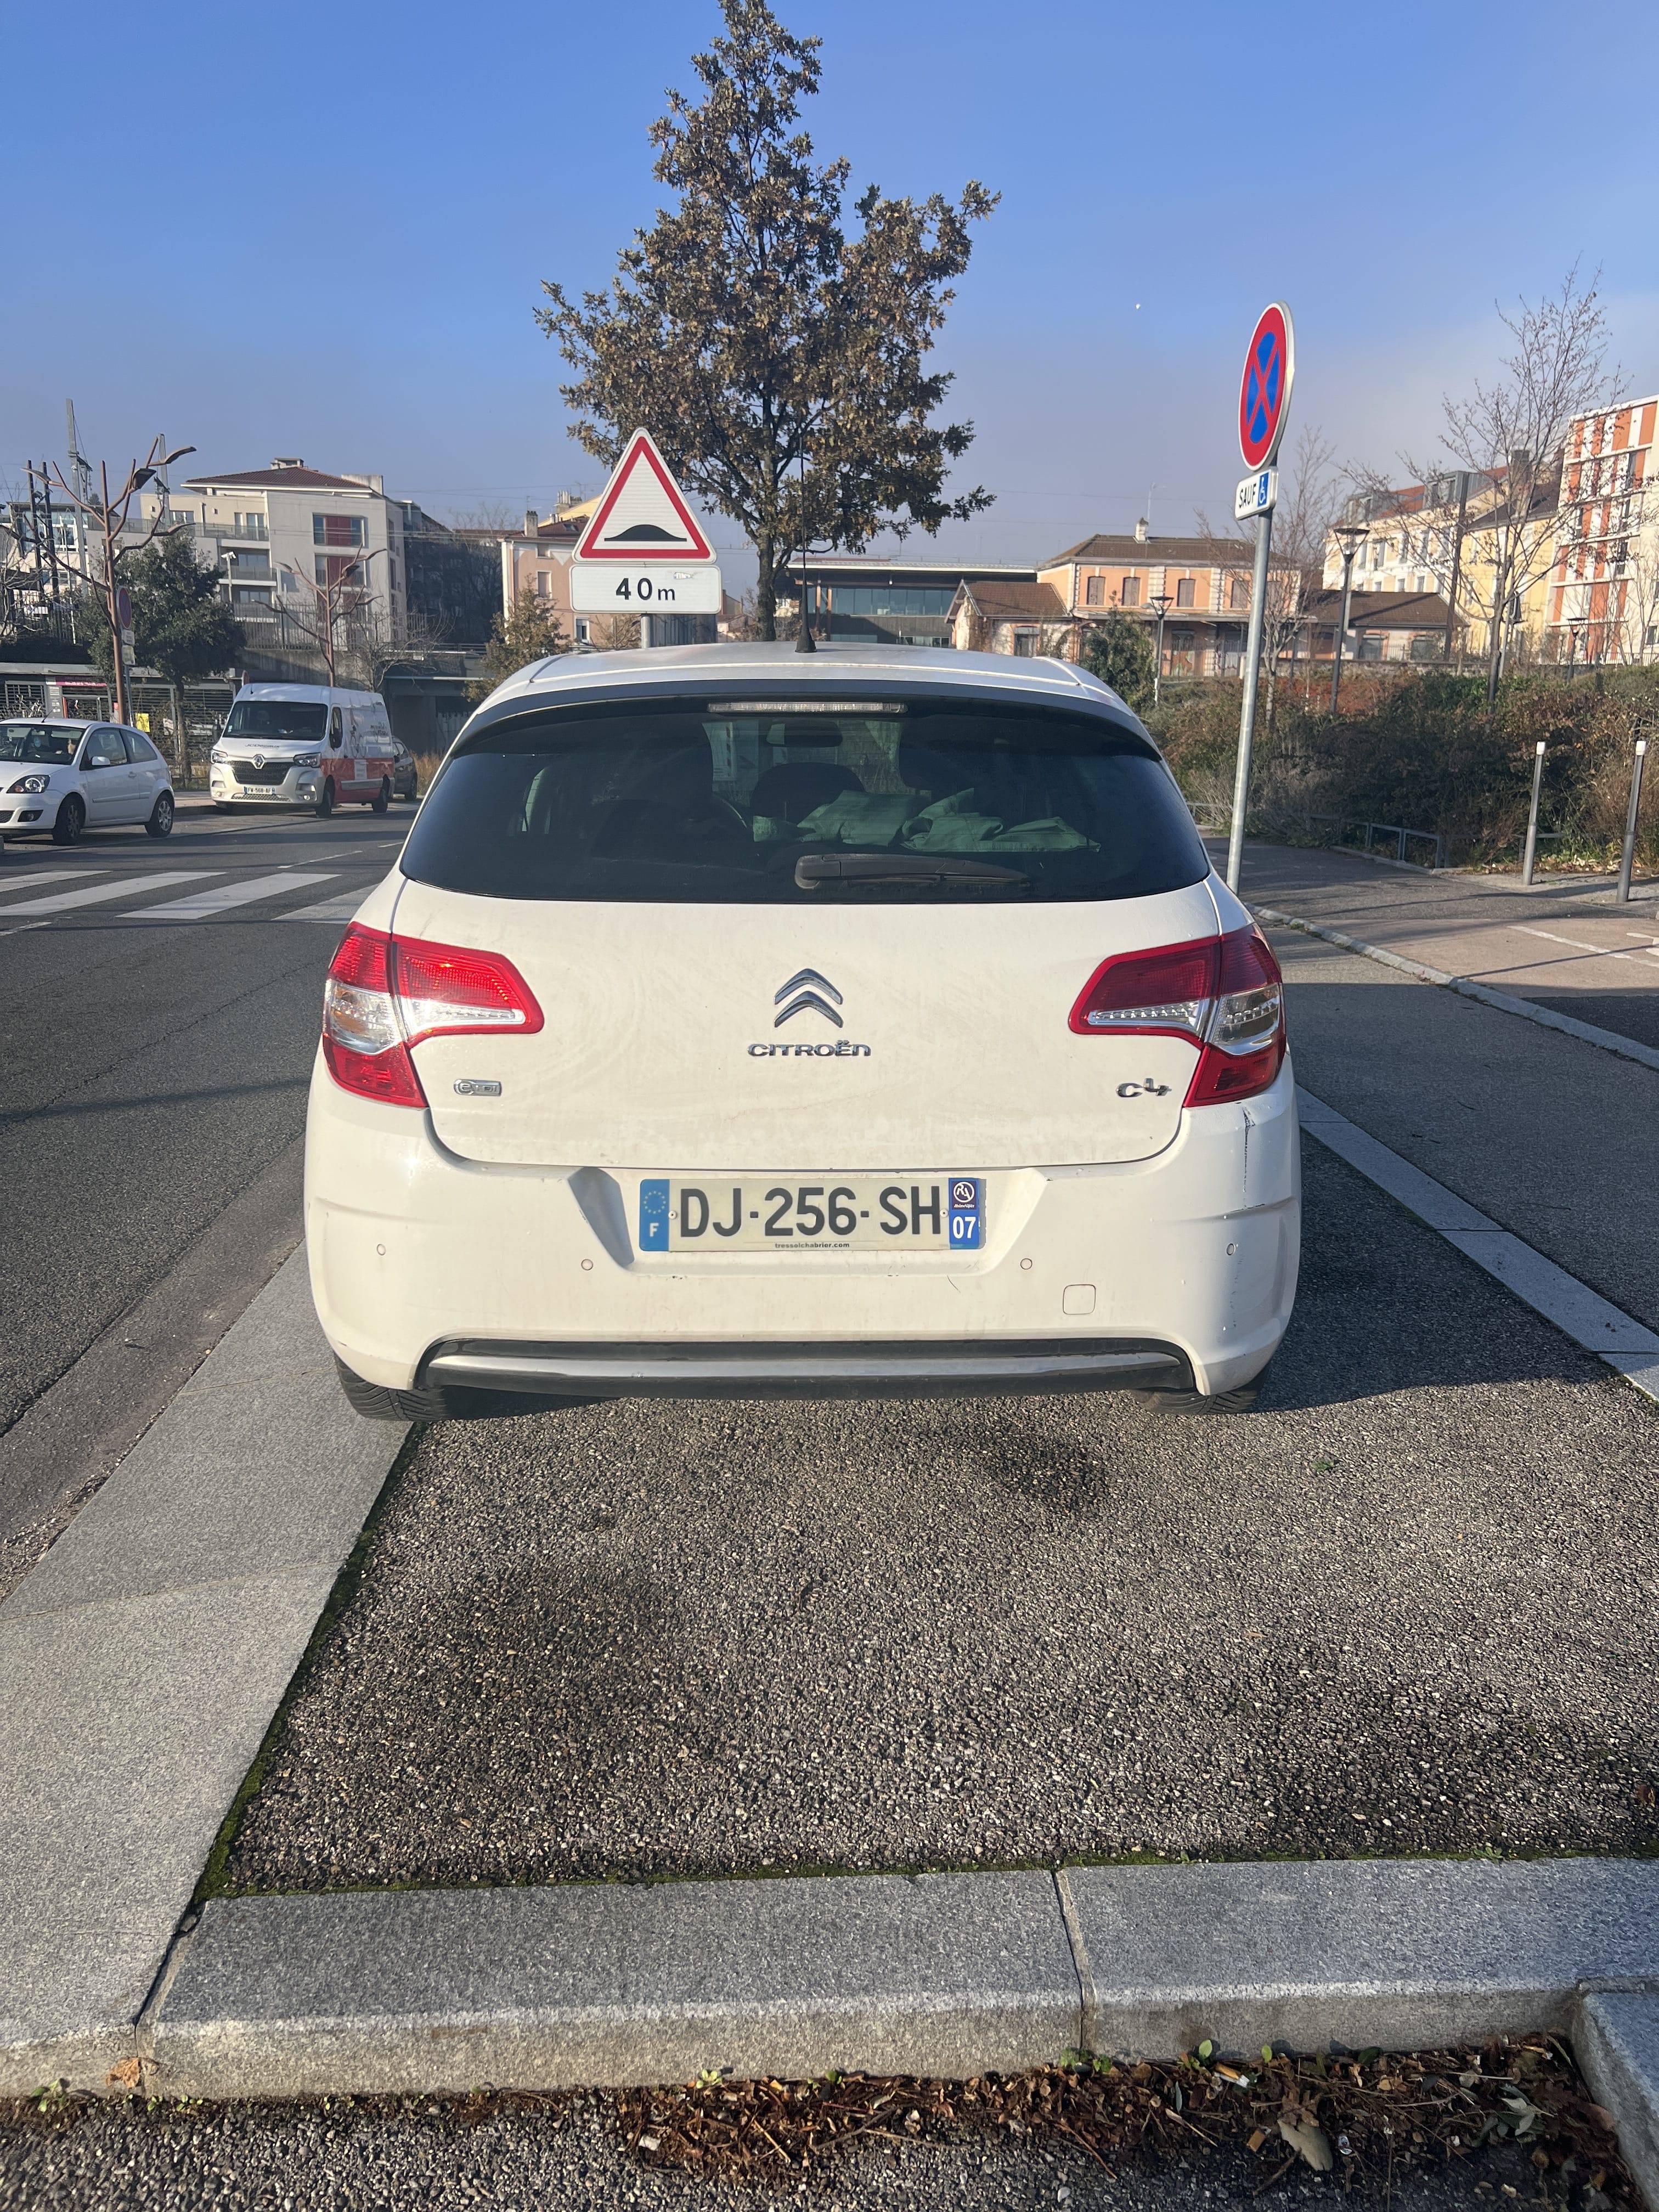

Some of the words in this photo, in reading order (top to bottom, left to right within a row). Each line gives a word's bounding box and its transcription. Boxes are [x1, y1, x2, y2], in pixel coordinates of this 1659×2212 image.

[1239, 483, 1257, 509] SAUF
[1116, 1078, 1172, 1098] C4
[680, 1186, 941, 1238] DJ-256-SH
[649, 1222, 659, 1237] F
[952, 1216, 977, 1239] 07
